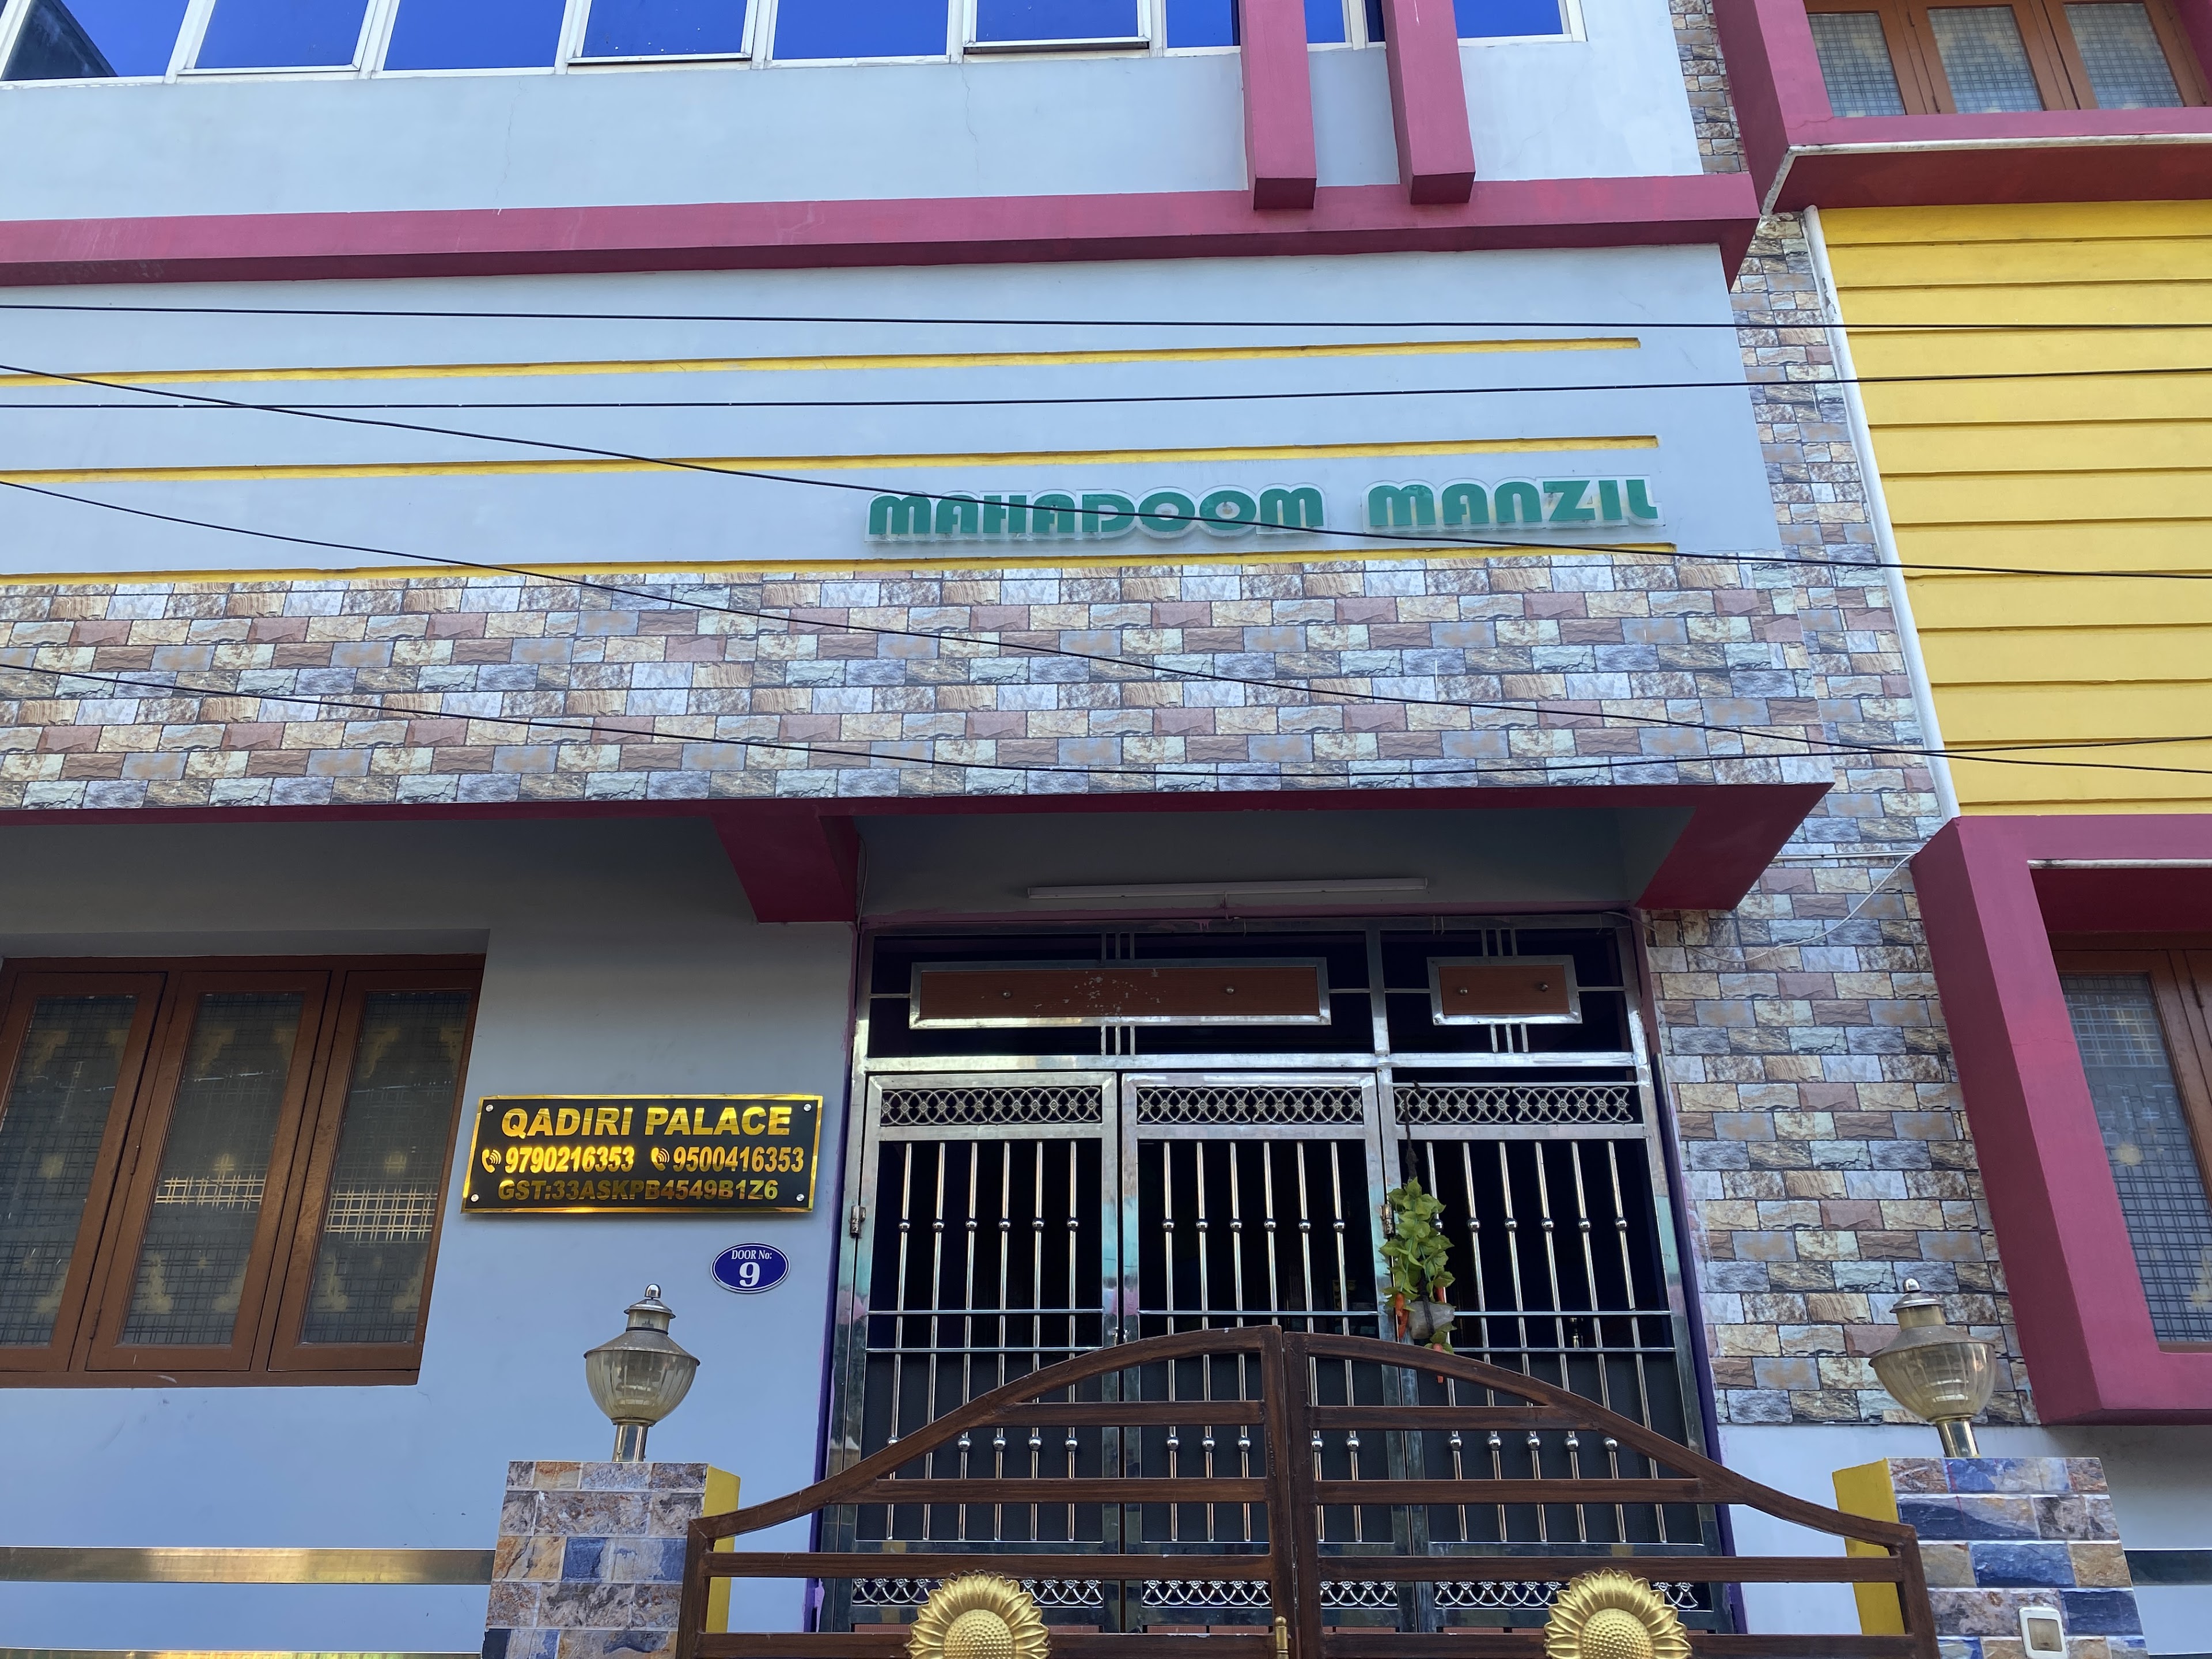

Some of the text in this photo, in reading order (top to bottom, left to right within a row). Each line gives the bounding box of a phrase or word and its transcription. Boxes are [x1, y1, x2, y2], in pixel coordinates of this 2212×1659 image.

[869, 479, 1658, 534] MAHADOOM MANZIL
[501, 1106, 792, 1139] QADIRI PALACE
[505, 1146, 804, 1173] 9790216353 9500416353
[498, 1180, 778, 1201] GST:33ASKPB4549B1Z6
[731, 1249, 772, 1260] DOOR No:
[739, 1262, 760, 1287] 9
